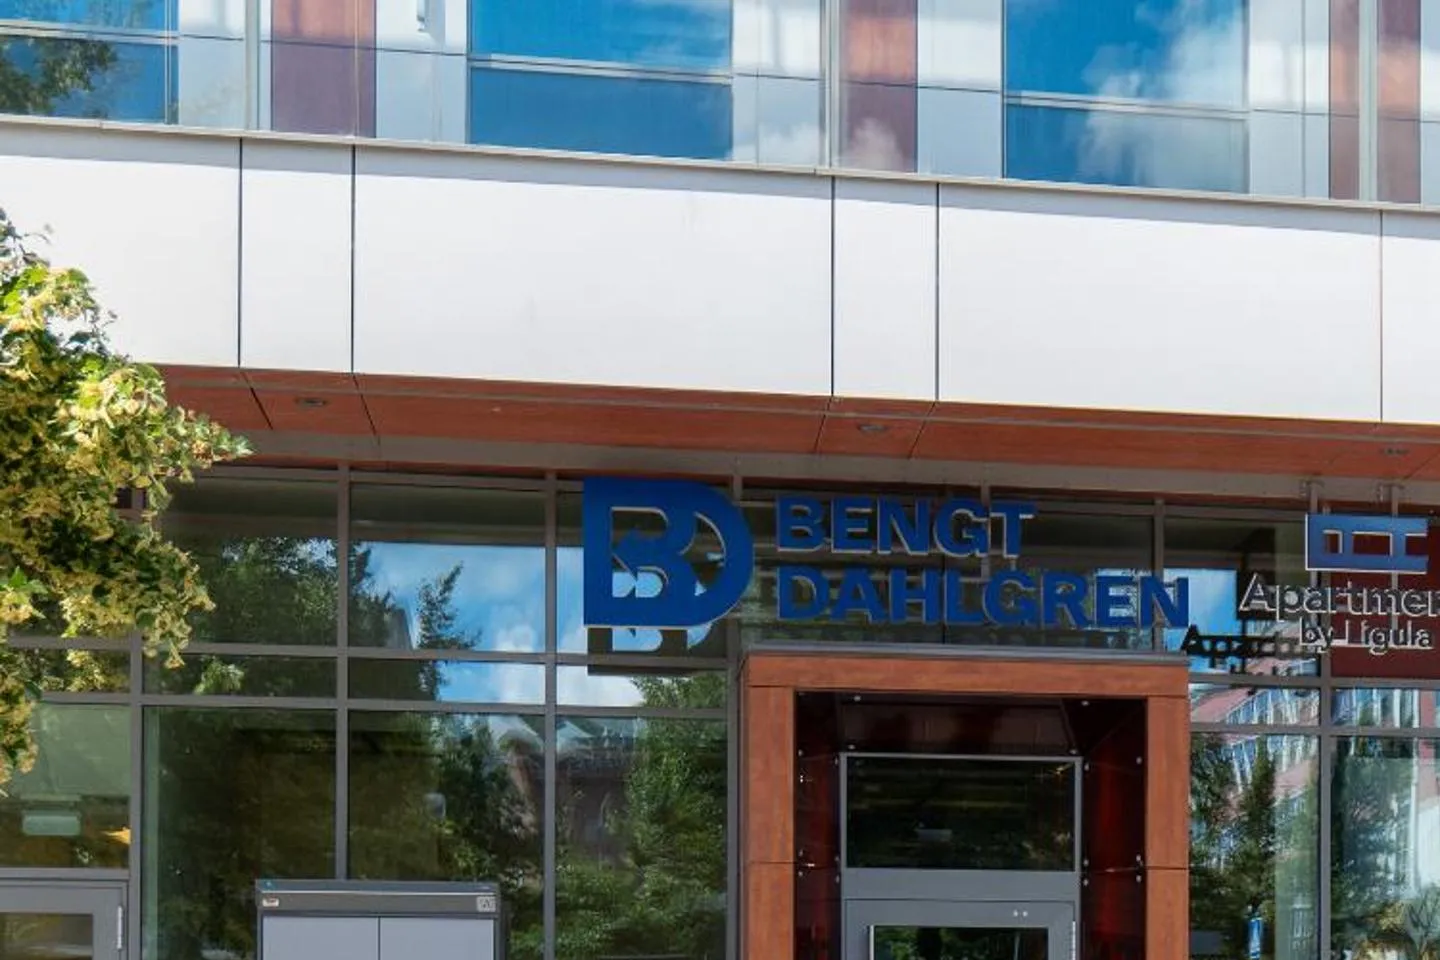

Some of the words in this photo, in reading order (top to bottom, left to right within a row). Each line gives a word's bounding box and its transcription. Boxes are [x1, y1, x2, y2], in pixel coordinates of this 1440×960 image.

[775, 498, 1036, 558] BENGT
[776, 566, 1189, 628] DAHLGREN
[1300, 614, 1333, 654] by
